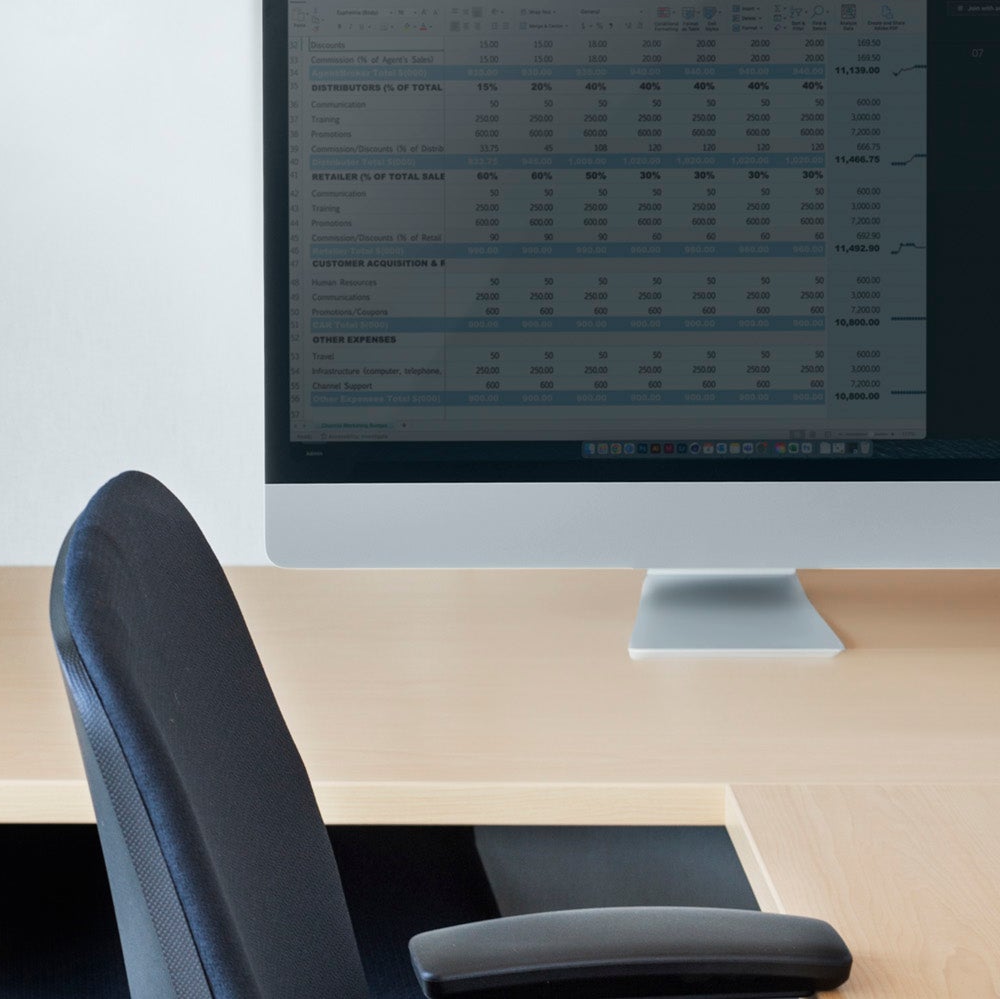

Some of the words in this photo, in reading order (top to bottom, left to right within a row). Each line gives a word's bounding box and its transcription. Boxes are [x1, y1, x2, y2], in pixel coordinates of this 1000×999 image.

[310, 41, 346, 50] Discounts
[479, 40, 500, 49] 15.00
[533, 39, 554, 49] 15.00
[588, 39, 608, 49] 18.00
[641, 39, 662, 49] 20.00
[695, 39, 717, 48] 20.00
[750, 39, 771, 48] 20.00
[804, 38, 825, 48] 20.00
[857, 38, 882, 48] 169.50
[310, 55, 355, 65] Commission
[381, 55, 409, 68] Agent's
[411, 55, 434, 64] Sales)
[857, 53, 882, 62] 169.50
[834, 66, 881, 75] 11,139.00
[311, 83, 381, 92] DISTRIBUTORS
[397, 83, 410, 92] OF
[412, 83, 443, 92] TOTAL
[476, 82, 499, 92] 15%
[530, 82, 553, 92] 20%
[584, 82, 607, 91] 40%
[639, 81, 662, 91] 40%
[693, 81, 716, 91] 40%
[747, 81, 770, 91] 40%
[801, 81, 824, 90] 40%
[310, 100, 367, 109] Communication
[856, 97, 882, 107] 600.00
[311, 115, 341, 126] Training
[474, 114, 500, 123] 250.00
[528, 113, 554, 123] 250.00
[583, 113, 608, 123] 250.00
[637, 113, 663, 123] 250.00
[691, 113, 717, 123] 250.00
[746, 113, 771, 122] 250.00
[799, 112, 825, 122] 250.00
[850, 112, 882, 122] 3,000.00
[310, 130, 353, 139] Promotions
[850, 127, 882, 137] 7,200.00
[311, 144, 394, 154] Commission/Discounts
[479, 143, 500, 153] 33.75
[543, 143, 554, 152] 45
[647, 143, 663, 153] 120
[702, 143, 717, 152] 120
[756, 142, 771, 152] 120
[811, 142, 825, 152] 120
[834, 155, 881, 164] 11,466.75
[311, 172, 358, 181] RETAILER
[373, 172, 386, 181] OF
[388, 172, 419, 181] TOTAL
[421, 172, 446, 181] SALE
[476, 171, 499, 181] 60%
[530, 171, 553, 181] 60%
[585, 171, 608, 180] 50%
[639, 170, 662, 180] 30%
[693, 170, 716, 180] 30%
[747, 170, 770, 180] 30%
[802, 170, 824, 180] 30%
[311, 189, 367, 198] Communication
[311, 204, 341, 214] Training
[851, 201, 882, 211] 3,000.00
[311, 219, 353, 228] Promotions
[851, 216, 881, 226] 7,200.00
[311, 233, 394, 242] Commission/Discounts
[421, 233, 443, 242] Retail
[489, 232, 500, 242] 90
[543, 232, 554, 241] 90
[597, 232, 609, 241] 90
[651, 231, 663, 241] 60
[705, 231, 717, 241] 60
[760, 231, 771, 241] 60
[814, 231, 825, 240] 60
[834, 244, 881, 253] 11,492.90
[312, 259, 365, 268] CUSTOMER
[367, 259, 428, 268] ACQUISITION
[311, 278, 337, 287] Human
[339, 278, 378, 287] Resources
[489, 277, 501, 287] 50
[543, 277, 554, 286] 50
[597, 276, 609, 286] 50
[652, 276, 663, 286] 50
[706, 276, 717, 285] 50
[760, 276, 771, 285] 50
[814, 275, 825, 285] 50
[856, 275, 881, 285] 600.00
[311, 293, 371, 302] Communications
[311, 308, 389, 317] Promotions/Coupons
[850, 305, 881, 314] 7,200.00
[834, 318, 881, 327] 10,800.00
[311, 335, 345, 344] OTHER
[346, 335, 397, 344] EXPENSES
[311, 351, 335, 361] Travel
[856, 349, 881, 359] 600.00
[311, 367, 361, 376] Infrastructure
[362, 367, 403, 376] (computer,
[850, 364, 881, 374] 3,000.00
[311, 381, 341, 391] Channel
[343, 381, 373, 391] Support
[485, 380, 500, 390] 600
[539, 380, 554, 389] 600
[593, 380, 609, 390] 600
[647, 380, 663, 389] 600
[701, 379, 717, 389] 600
[756, 379, 771, 389] 600
[809, 379, 825, 389] 600
[850, 379, 881, 389] 7,200.00
[834, 391, 881, 401] 10,800.00
